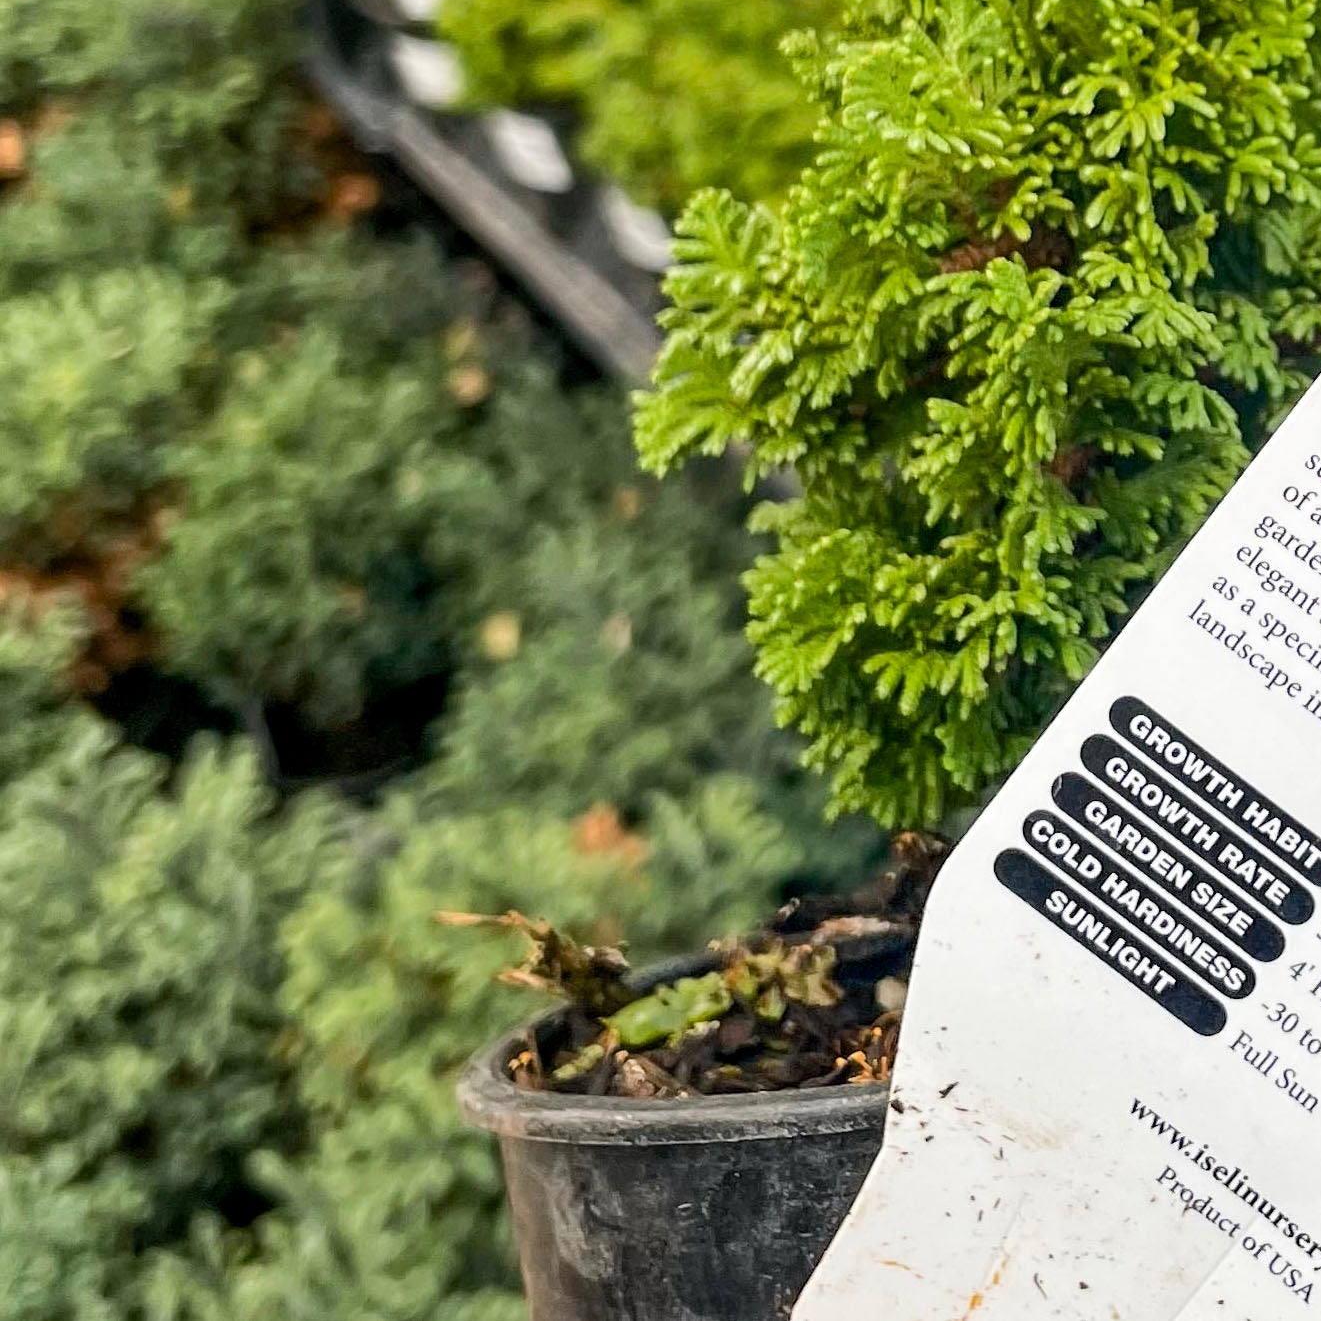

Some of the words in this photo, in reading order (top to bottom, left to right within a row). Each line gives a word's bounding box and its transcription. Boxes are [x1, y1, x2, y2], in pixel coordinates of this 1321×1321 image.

[1282, 485, 1318, 511] of
[1212, 576, 1239, 601] as
[1240, 598, 1256, 617] a
[1236, 546, 1320, 616] elegant
[1187, 598, 1302, 698] landscape
[1129, 714, 1245, 809] GROWTH
[1084, 800, 1193, 890] GARDEN
[1191, 882, 1254, 937] SIZE
[1105, 757, 1220, 851] GROWTH
[1217, 843, 1291, 906] RATE
[1031, 819, 1102, 879] COLD
[1100, 872, 1246, 991] HARDINESS
[1045, 890, 1177, 993] SUNLIGHT
[1261, 1002, 1300, 1033] -30
[1228, 1029, 1279, 1077] Full
[1274, 1068, 1319, 1114] Sun
[1155, 1164, 1241, 1239] Product
[1242, 1236, 1273, 1260] of
[1268, 1252, 1314, 1304] USA
